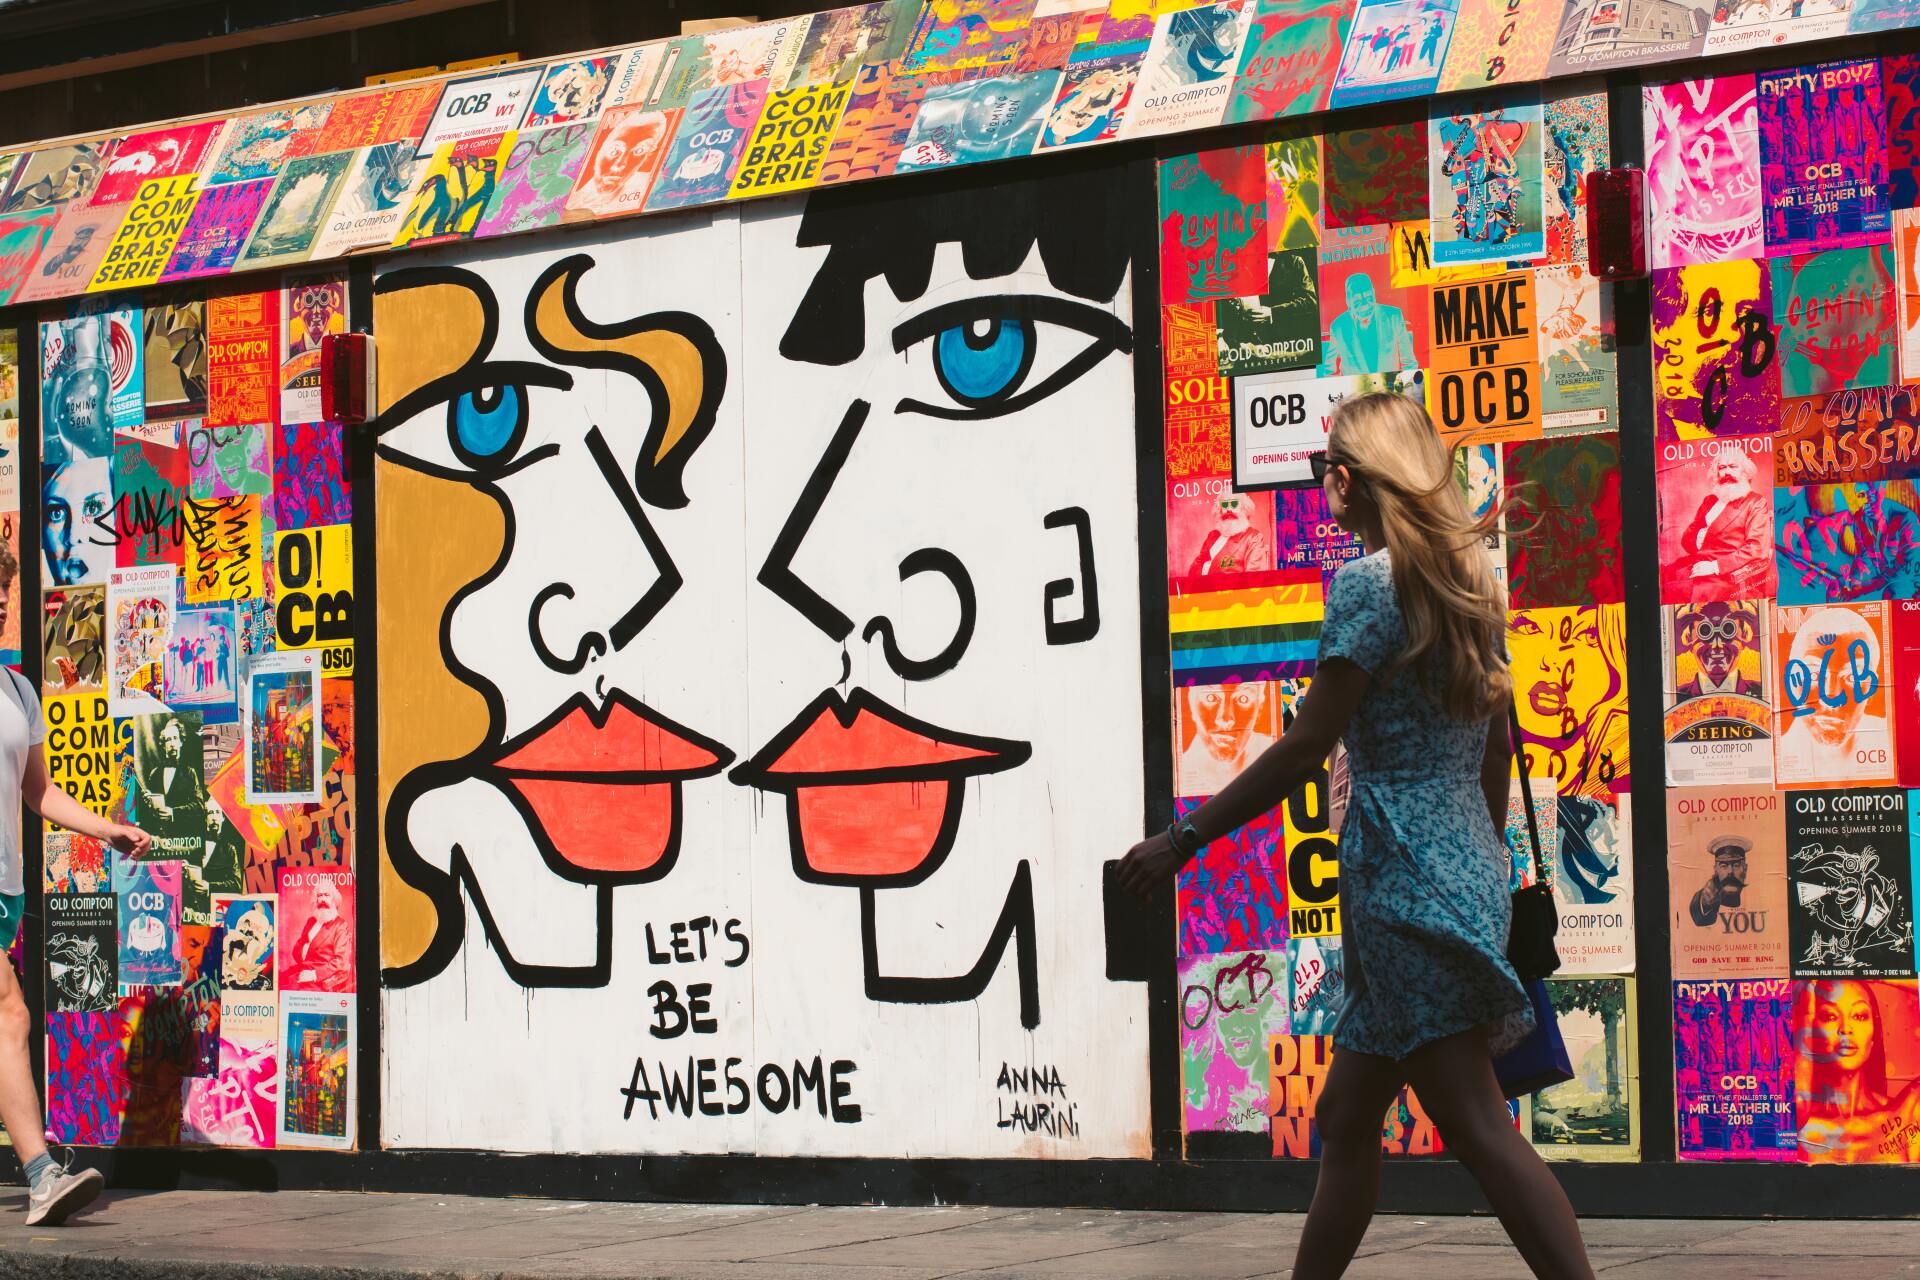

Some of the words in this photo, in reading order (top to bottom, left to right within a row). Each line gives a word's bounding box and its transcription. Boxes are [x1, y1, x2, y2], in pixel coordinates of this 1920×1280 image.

[1791, 22, 1823, 31] OPENING
[1708, 34, 1727, 45] OLD
[1729, 29, 1771, 42] COMPTON
[1566, 55, 1587, 65] OLD
[1588, 49, 1639, 62] COMPTON
[1640, 41, 1691, 55] BRASSERIE
[1822, 63, 1874, 89] BOYZ
[446, 92, 492, 118] OCB
[766, 91, 847, 120] COM
[1144, 96, 1168, 108] OLD
[1171, 84, 1227, 104] COMPTON
[986, 95, 1008, 133] COMING
[1002, 100, 1020, 129] SOON
[1138, 112, 1182, 127] OPENING
[1183, 106, 1221, 119] SUMMER
[1168, 119, 1186, 127] 2018
[434, 132, 463, 142] OPENING
[464, 128, 492, 137] SUMMER
[493, 124, 509, 133] 2018
[688, 128, 735, 149] OCB
[754, 113, 837, 144] PTON
[455, 142, 469, 151] OLD
[470, 137, 501, 149] COMPTON
[746, 135, 828, 167] BRAS
[736, 159, 820, 190] SERIE
[1804, 162, 1842, 181] OCB
[1782, 186, 1800, 195] MEET
[1802, 184, 1816, 193] THE
[1817, 180, 1853, 191] FINALISTS
[1854, 177, 1868, 186] FOR
[102, 193, 118, 201] OCB
[618, 191, 641, 204] OCB
[1773, 196, 1795, 209] MR
[1797, 187, 1857, 206] LEATHER
[1860, 185, 1877, 197] UK
[129, 196, 195, 222] COM
[1812, 201, 1839, 215] 2018
[116, 216, 185, 243] PTON
[204, 226, 227, 238] OCB
[333, 220, 353, 232] OLD
[354, 212, 398, 228] COMPTON
[105, 238, 173, 263] BRAS
[1321, 240, 1391, 265] NORMAN
[95, 258, 163, 284] SERIE
[1433, 278, 1530, 346] MAKE
[45, 337, 63, 361] OLD
[209, 345, 225, 358] OLD
[226, 339, 269, 357] COMPTON
[1228, 346, 1253, 363] OLD
[1257, 337, 1314, 358] COMPTON
[1469, 343, 1500, 367] IT
[1244, 356, 1299, 369] BRASSERIE
[1663, 337, 1684, 397] 2018
[1169, 376, 1230, 405] SOH
[1555, 378, 1582, 386] PLEASURE
[1582, 375, 1605, 383] PARTIES
[113, 391, 141, 403] COMPTON
[297, 390, 309, 398] OLD
[1440, 367, 1531, 428] OCB
[65, 397, 96, 413] COMING
[1250, 393, 1307, 428] OCB
[1823, 384, 1918, 428] COMPT
[69, 414, 92, 428] SOON
[1252, 452, 1289, 465] OPENING
[1663, 443, 1694, 461] OLD
[1700, 436, 1773, 456] COMPTON
[1174, 483, 1200, 498] OLD
[1287, 552, 1305, 562] MR
[1308, 548, 1360, 561] LEATHER
[1313, 541, 1324, 549] THE
[125, 572, 138, 582] OLD
[140, 569, 170, 580] COMPTON
[1321, 560, 1345, 571] 2018
[1784, 638, 1880, 717] OCB
[48, 698, 108, 725] OLD
[49, 725, 109, 752] COM
[1687, 725, 1754, 741] SEEING
[1690, 744, 1708, 755] OLD
[1711, 742, 1753, 754] COMPTON
[1855, 749, 1887, 764] OCB
[50, 751, 110, 778] PTON
[204, 760, 225, 770] COMPT
[1678, 799, 1706, 815] OLD
[1711, 795, 1777, 812] COMPTON
[1795, 797, 1826, 814] OLD
[1831, 794, 1904, 813] COMPTON
[1816, 813, 1884, 821] BRASSERIE
[1798, 826, 1838, 835] OPENING
[1841, 825, 1877, 834] SUMMER
[1879, 824, 1903, 833] 2018
[159, 836, 202, 850] COMPTON
[283, 873, 303, 887] OLD
[306, 872, 353, 886] COMPTON
[50, 898, 68, 911] OLD
[71, 896, 113, 910] COMPTON
[128, 892, 165, 911] OCB
[1291, 907, 1336, 935] NOT
[1561, 914, 1623, 929] COMPTON
[1719, 910, 1767, 934] YOU
[644, 915, 750, 968] LET'S
[1581, 946, 1623, 955] SUMMER
[1684, 943, 1722, 952] OPENING
[1724, 943, 1758, 951] SUMMER
[1761, 942, 1781, 950] 2018
[1692, 957, 1708, 965] GOD
[1755, 955, 1774, 963] KING
[1294, 959, 1320, 989] OLD
[1183, 952, 1274, 1030] OCB
[1291, 967, 1344, 1012] COMPTON
[1738, 978, 1790, 1000] BOYZ
[233, 1003, 275, 1017] COMPTON
[646, 979, 719, 1040] BE
[619, 1054, 863, 1124] AWESOME
[996, 1061, 1067, 1100] ANNA
[1720, 1075, 1758, 1090] OCB
[1689, 1103, 1709, 1115] MR
[1713, 1102, 1770, 1114] LEATHER
[1774, 1102, 1791, 1113] UK
[1727, 1114, 1754, 1126] 2018
[1881, 1116, 1903, 1138] OLD
[1878, 1120, 1920, 1154] COMPTON
